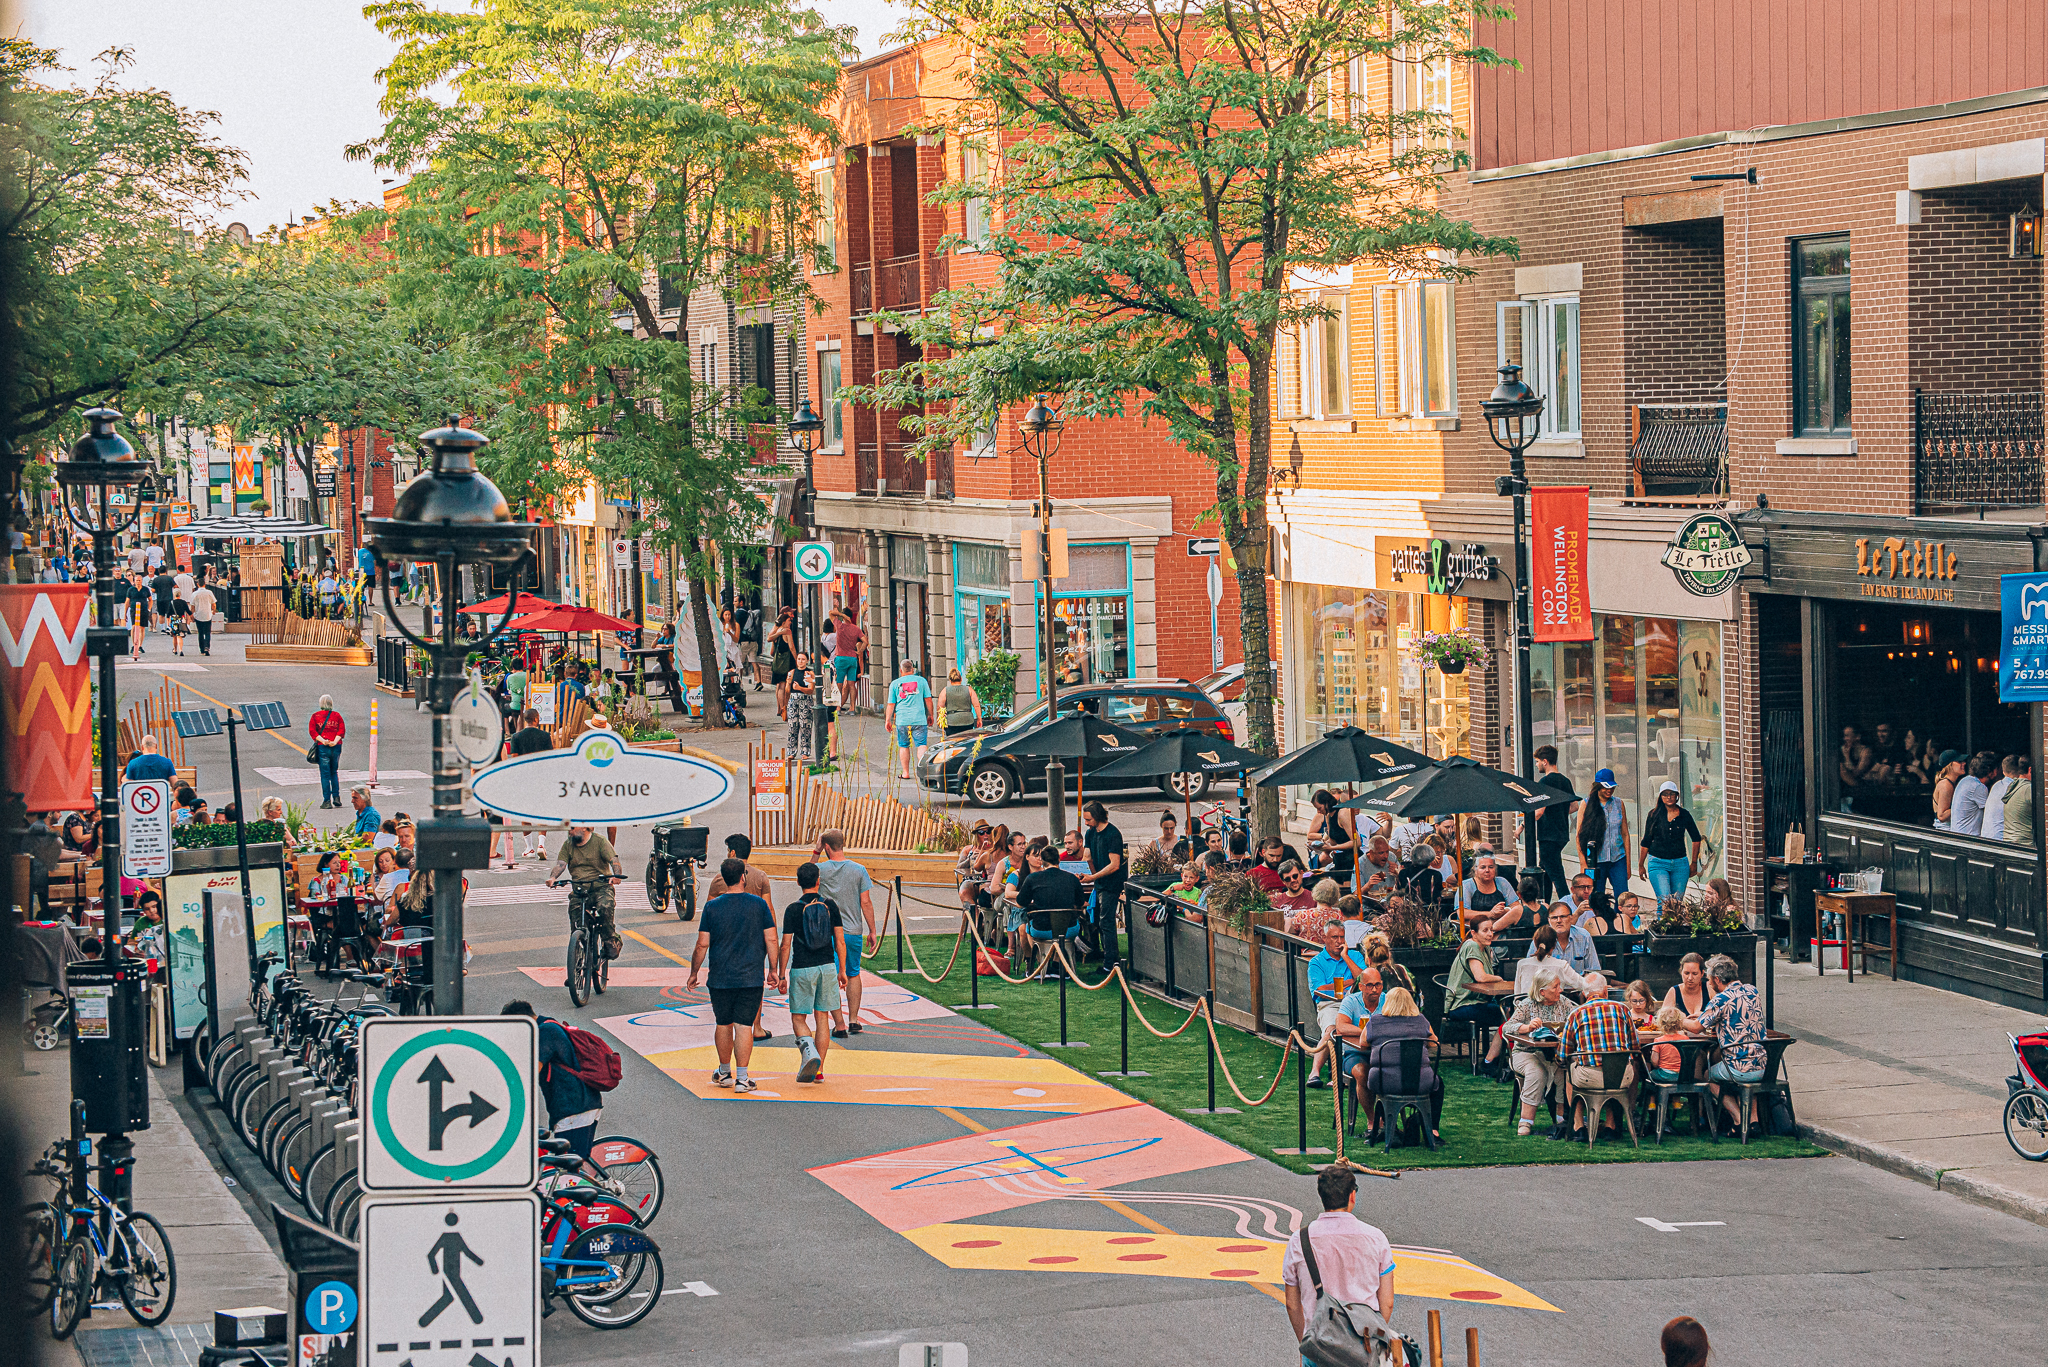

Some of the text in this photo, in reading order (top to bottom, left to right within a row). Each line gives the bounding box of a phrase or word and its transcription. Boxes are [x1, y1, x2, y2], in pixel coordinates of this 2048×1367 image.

[1390, 544, 1489, 587] pattes griffes
[1673, 549, 1745, 569] Le Trèfle
[1855, 537, 1958, 580] Le Trèfle
[1554, 525, 1569, 625] WELLINGTON
[1567, 531, 1582, 624] PROMENADE
[1683, 571, 1736, 594] TAVERNE IRLANDAISE
[1860, 583, 1955, 602] TAVERNE IRLANDAISE
[1040, 602, 1124, 615] FOMAGERIE
[1542, 585, 1555, 625] .COM
[1045, 643, 1092, 656] opette
[1201, 760, 1240, 769] GUINNESS
[1377, 763, 1417, 774] GUINNESS
[579, 781, 650, 797] Avenue
